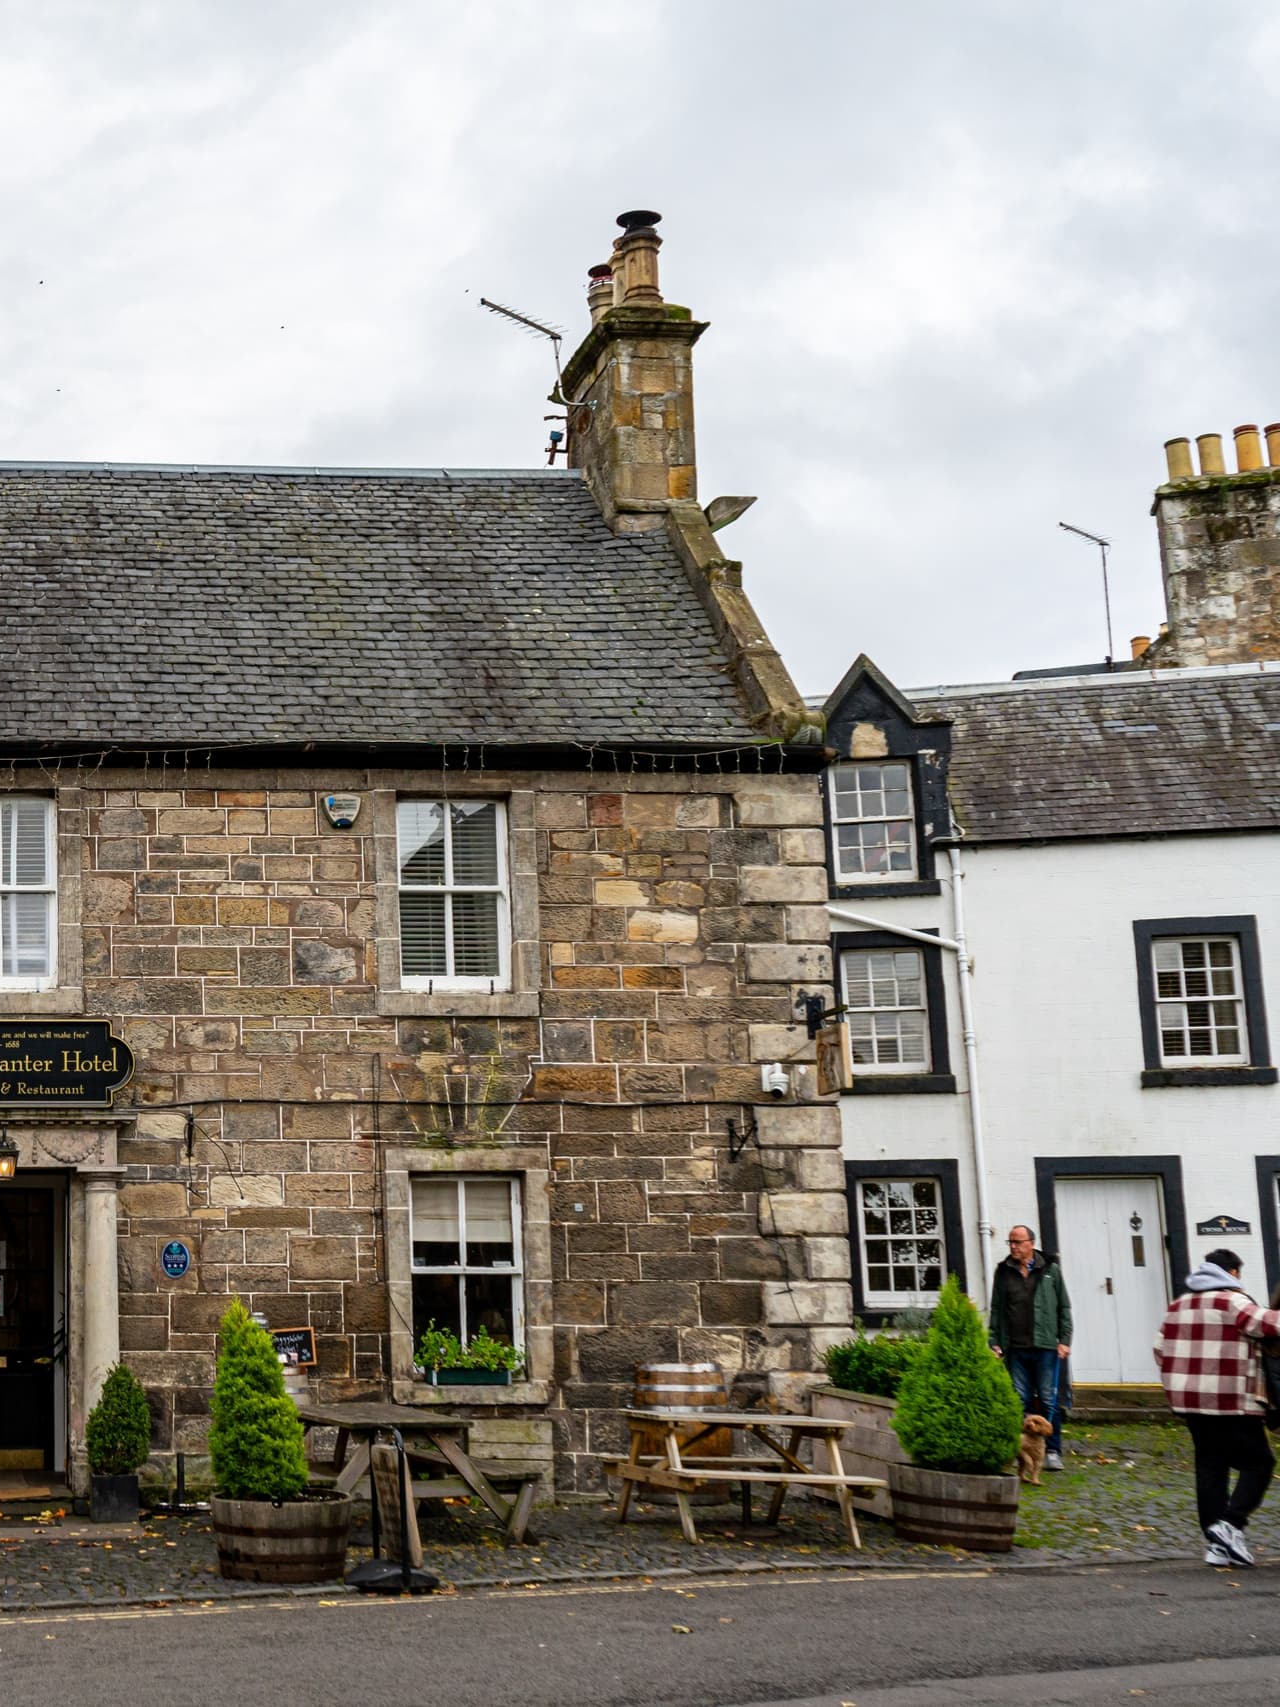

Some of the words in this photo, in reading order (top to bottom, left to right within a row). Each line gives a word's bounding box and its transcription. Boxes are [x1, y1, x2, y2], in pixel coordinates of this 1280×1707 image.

[13, 1031, 26, 1039] and
[39, 1031, 52, 1039] will
[53, 1031, 72, 1039] make
[60, 1047, 119, 1072] Hotel
[0, 1081, 12, 1095] &
[16, 1081, 85, 1095] Restaurant
